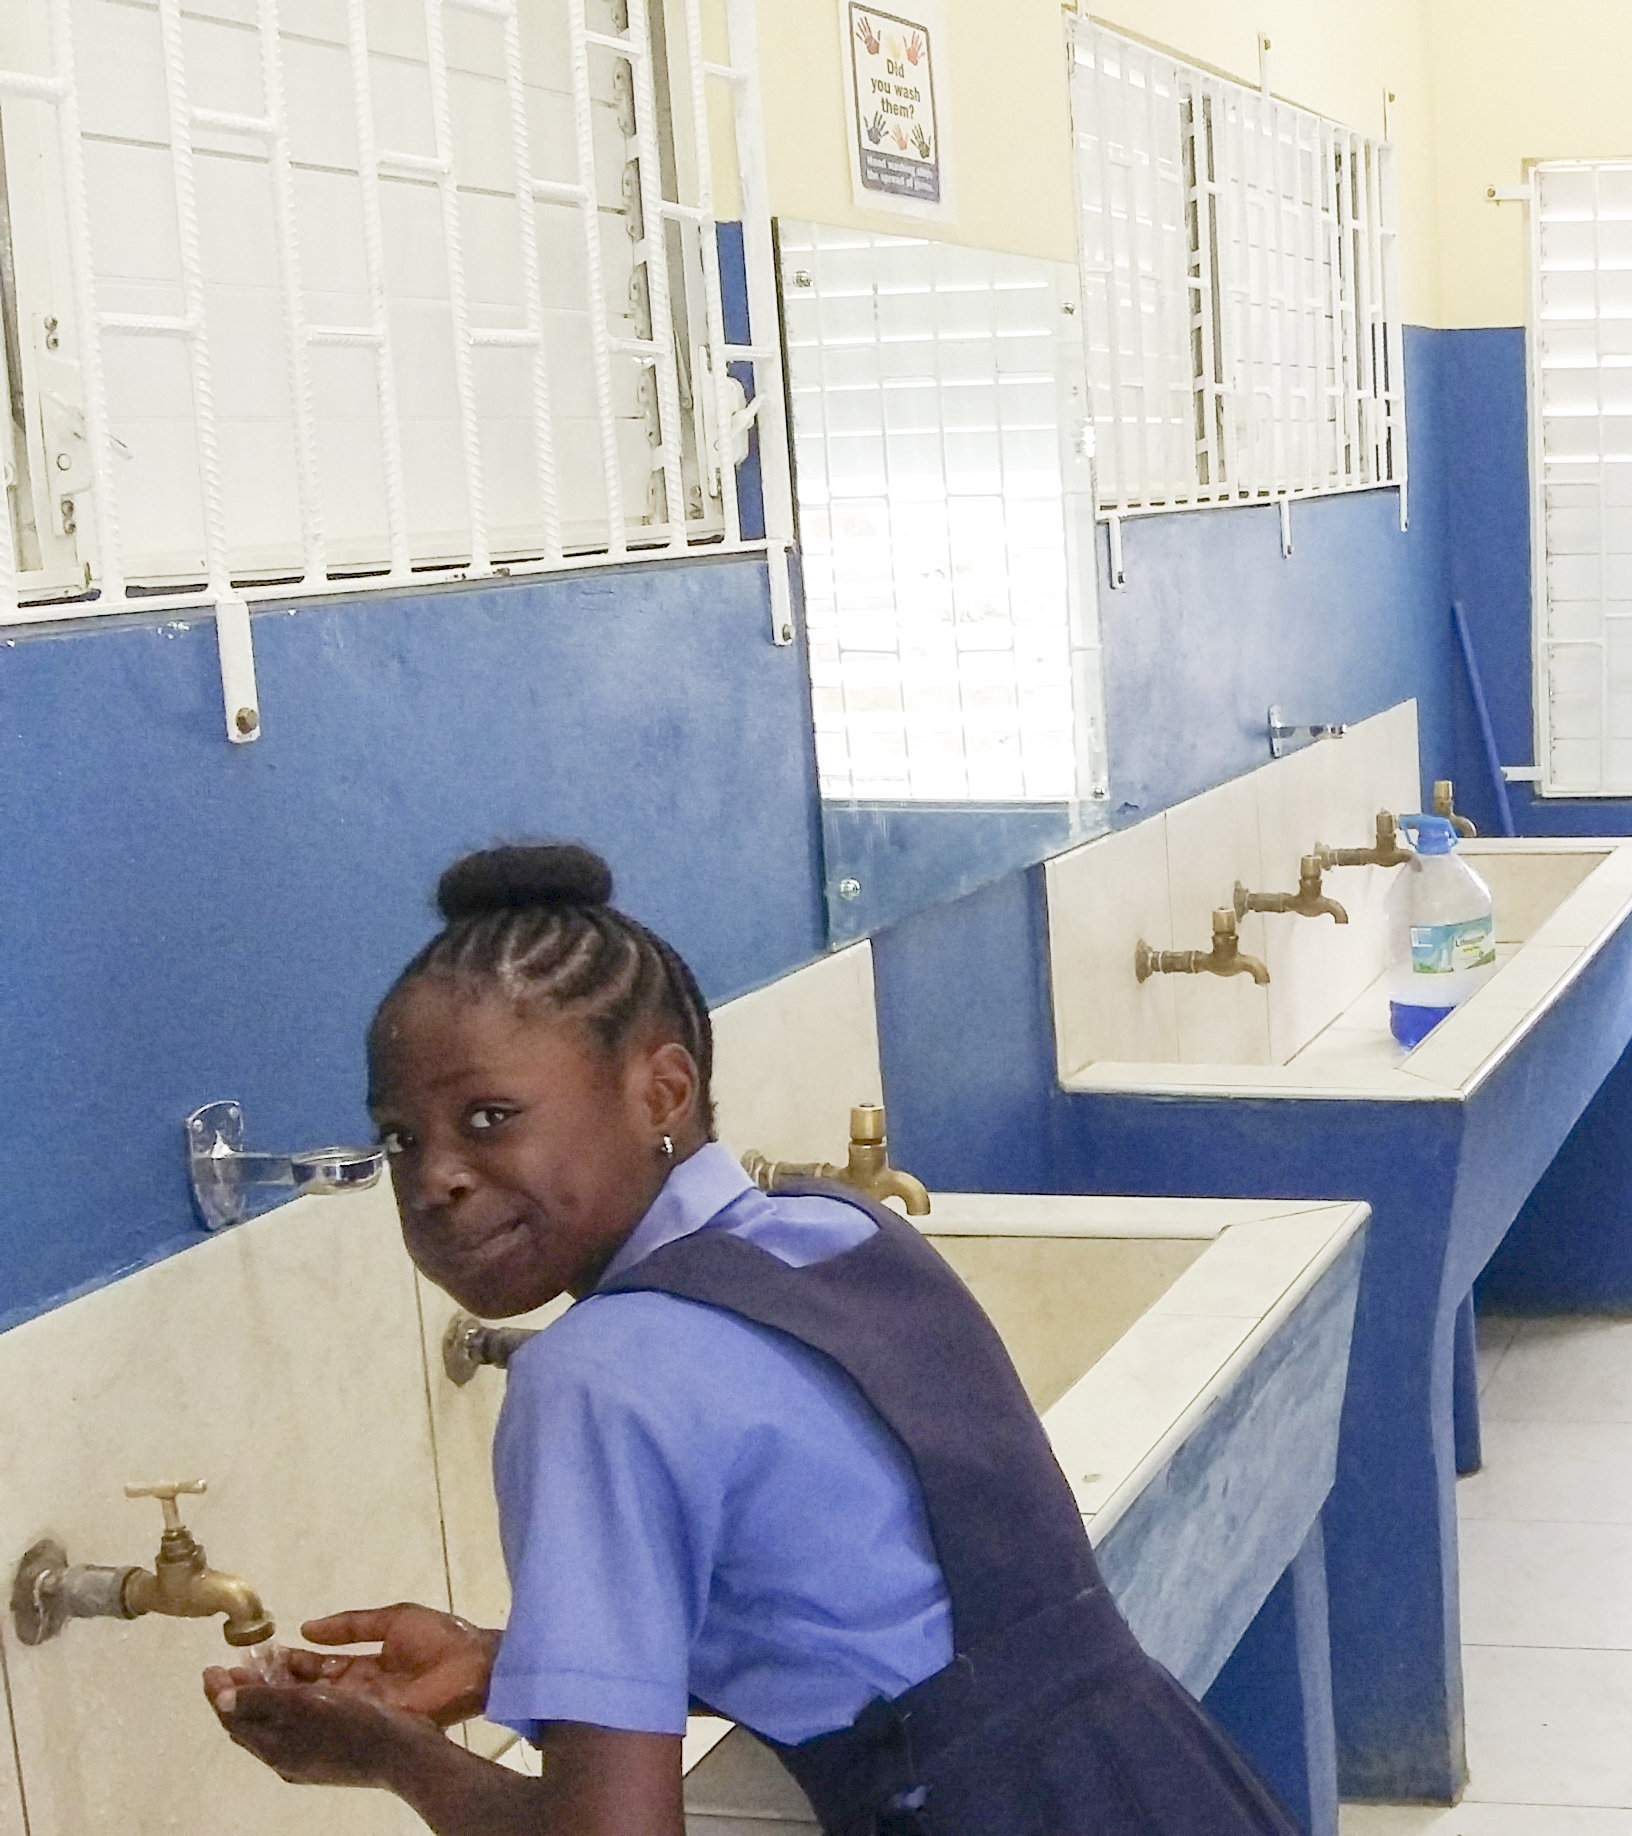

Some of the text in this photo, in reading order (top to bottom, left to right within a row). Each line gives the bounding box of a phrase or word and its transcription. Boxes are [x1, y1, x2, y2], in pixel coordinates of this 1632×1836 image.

[886, 59, 905, 79] Did
[870, 78, 921, 103] you wash
[881, 97, 915, 120] them?
